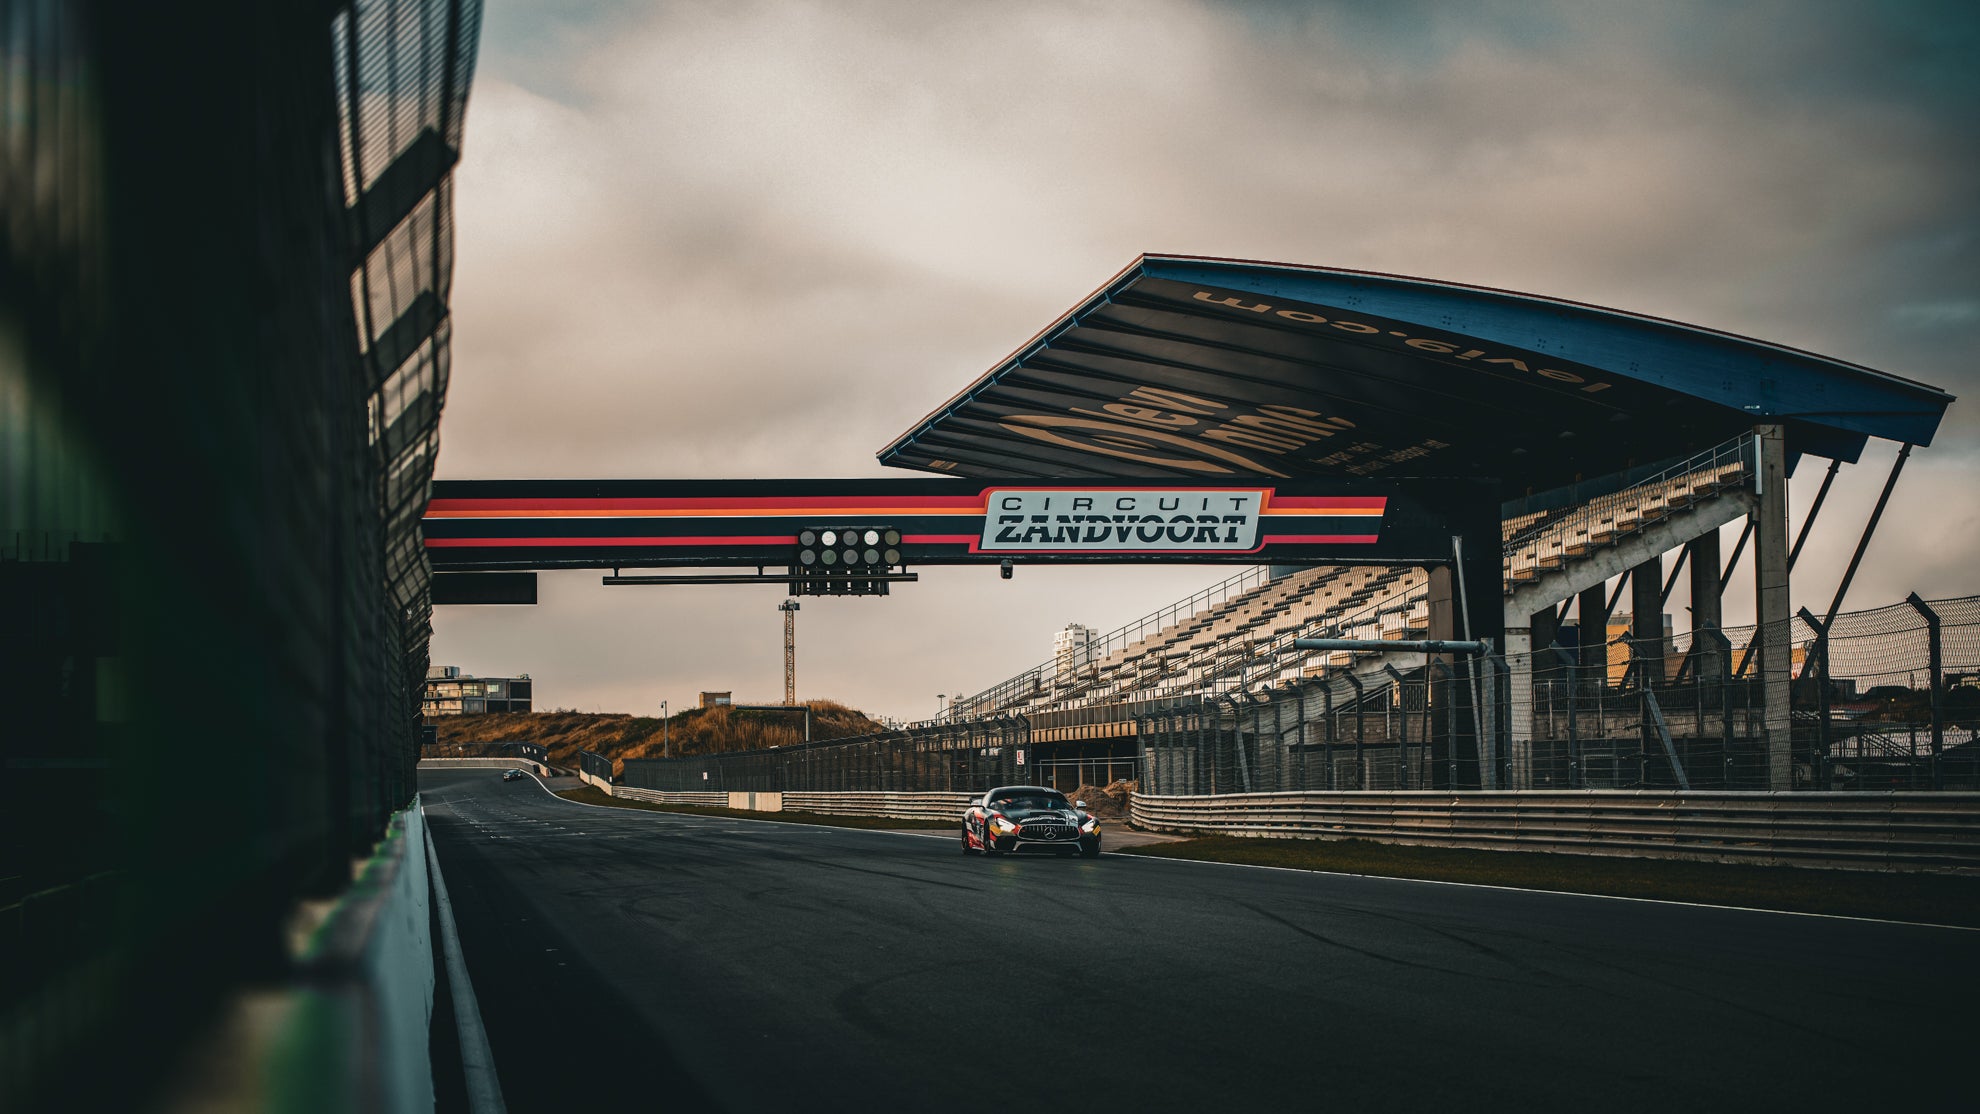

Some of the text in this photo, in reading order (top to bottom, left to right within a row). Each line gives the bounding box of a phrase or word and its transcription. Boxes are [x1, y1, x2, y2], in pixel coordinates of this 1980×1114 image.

[1193, 291, 1612, 393] levi9.com
[1001, 497, 1247, 511] CIRCUIT
[995, 515, 1246, 543] ZANDVOORT
